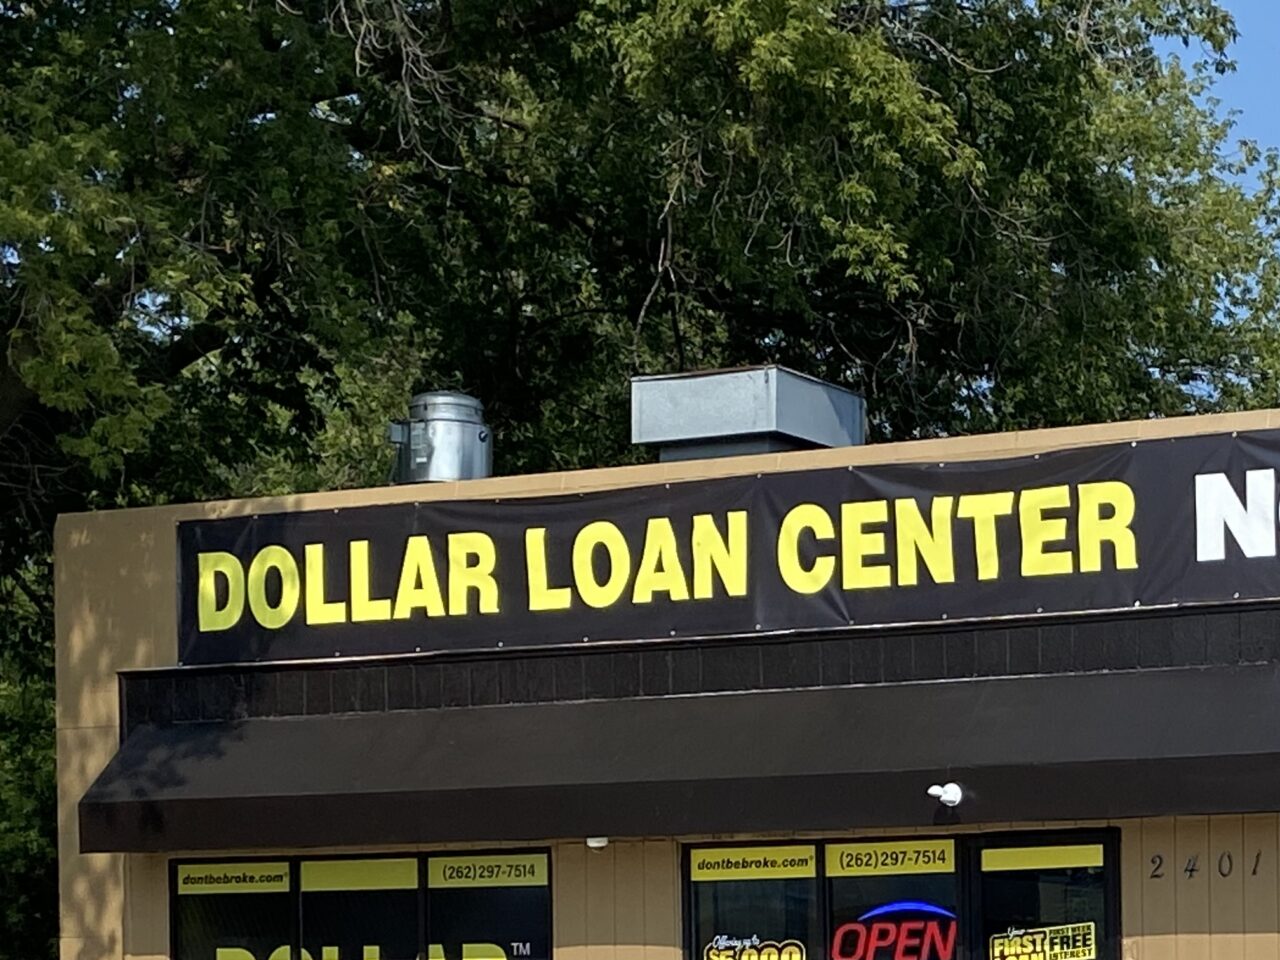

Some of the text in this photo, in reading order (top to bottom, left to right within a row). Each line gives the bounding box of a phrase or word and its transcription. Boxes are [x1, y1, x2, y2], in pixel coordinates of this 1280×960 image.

[198, 532, 499, 632] DOLLAR
[526, 511, 748, 611] LOAN
[777, 481, 1138, 594] CENTER
[994, 934, 1045, 956] FIRST
[1050, 933, 1092, 951] FREE
